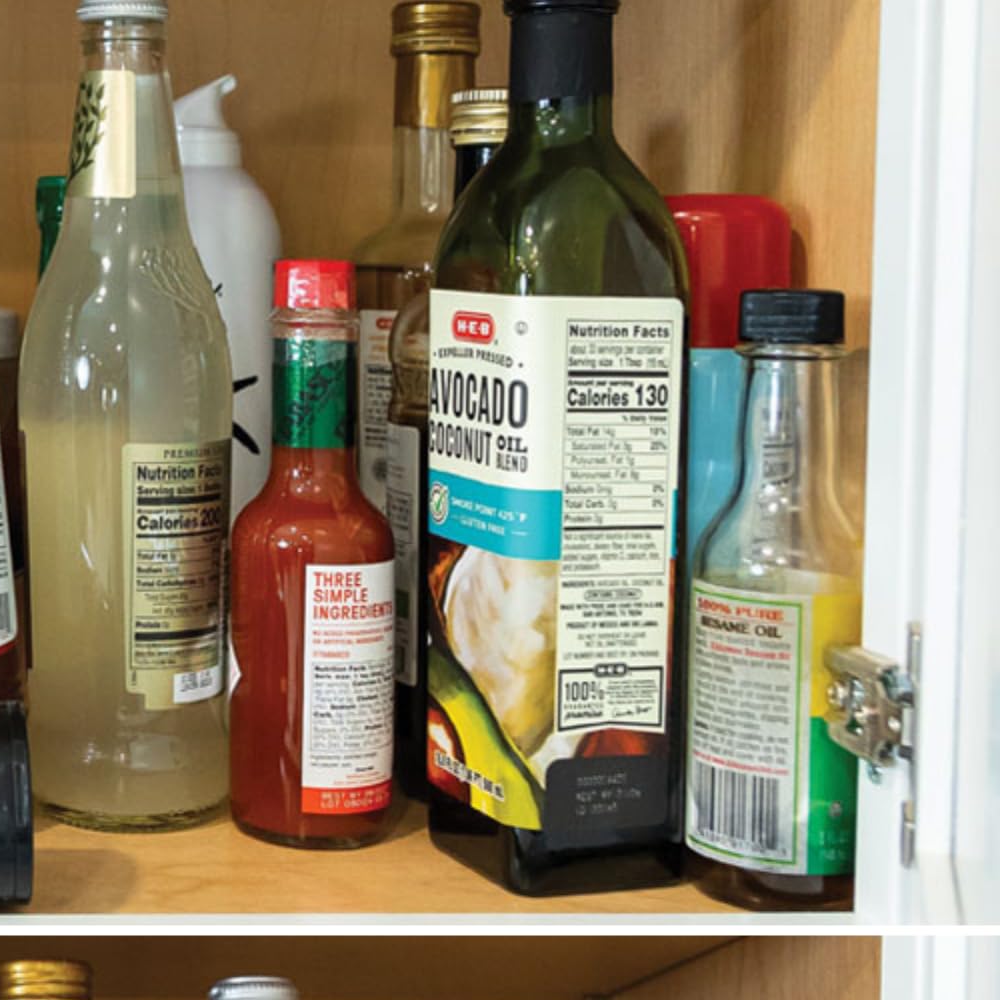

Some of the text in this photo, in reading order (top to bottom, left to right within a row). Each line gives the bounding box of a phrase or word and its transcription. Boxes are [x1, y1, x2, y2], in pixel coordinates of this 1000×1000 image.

[569, 325, 670, 338] Nutrition Facts
[476, 351, 514, 368] PRESSED
[430, 367, 529, 428] AVOCADO
[567, 383, 669, 407] Calories 130
[428, 420, 492, 466] COCONUT
[496, 435, 529, 453] OIL
[496, 453, 529, 473] BLEND
[137, 464, 196, 481] Nutrition
[137, 485, 174, 497] Serving
[136, 515, 198, 530] Calories
[313, 571, 362, 588] THREE
[313, 588, 369, 603] SIMPLE
[754, 625, 782, 639] OIL
[564, 681, 605, 702] 100%
